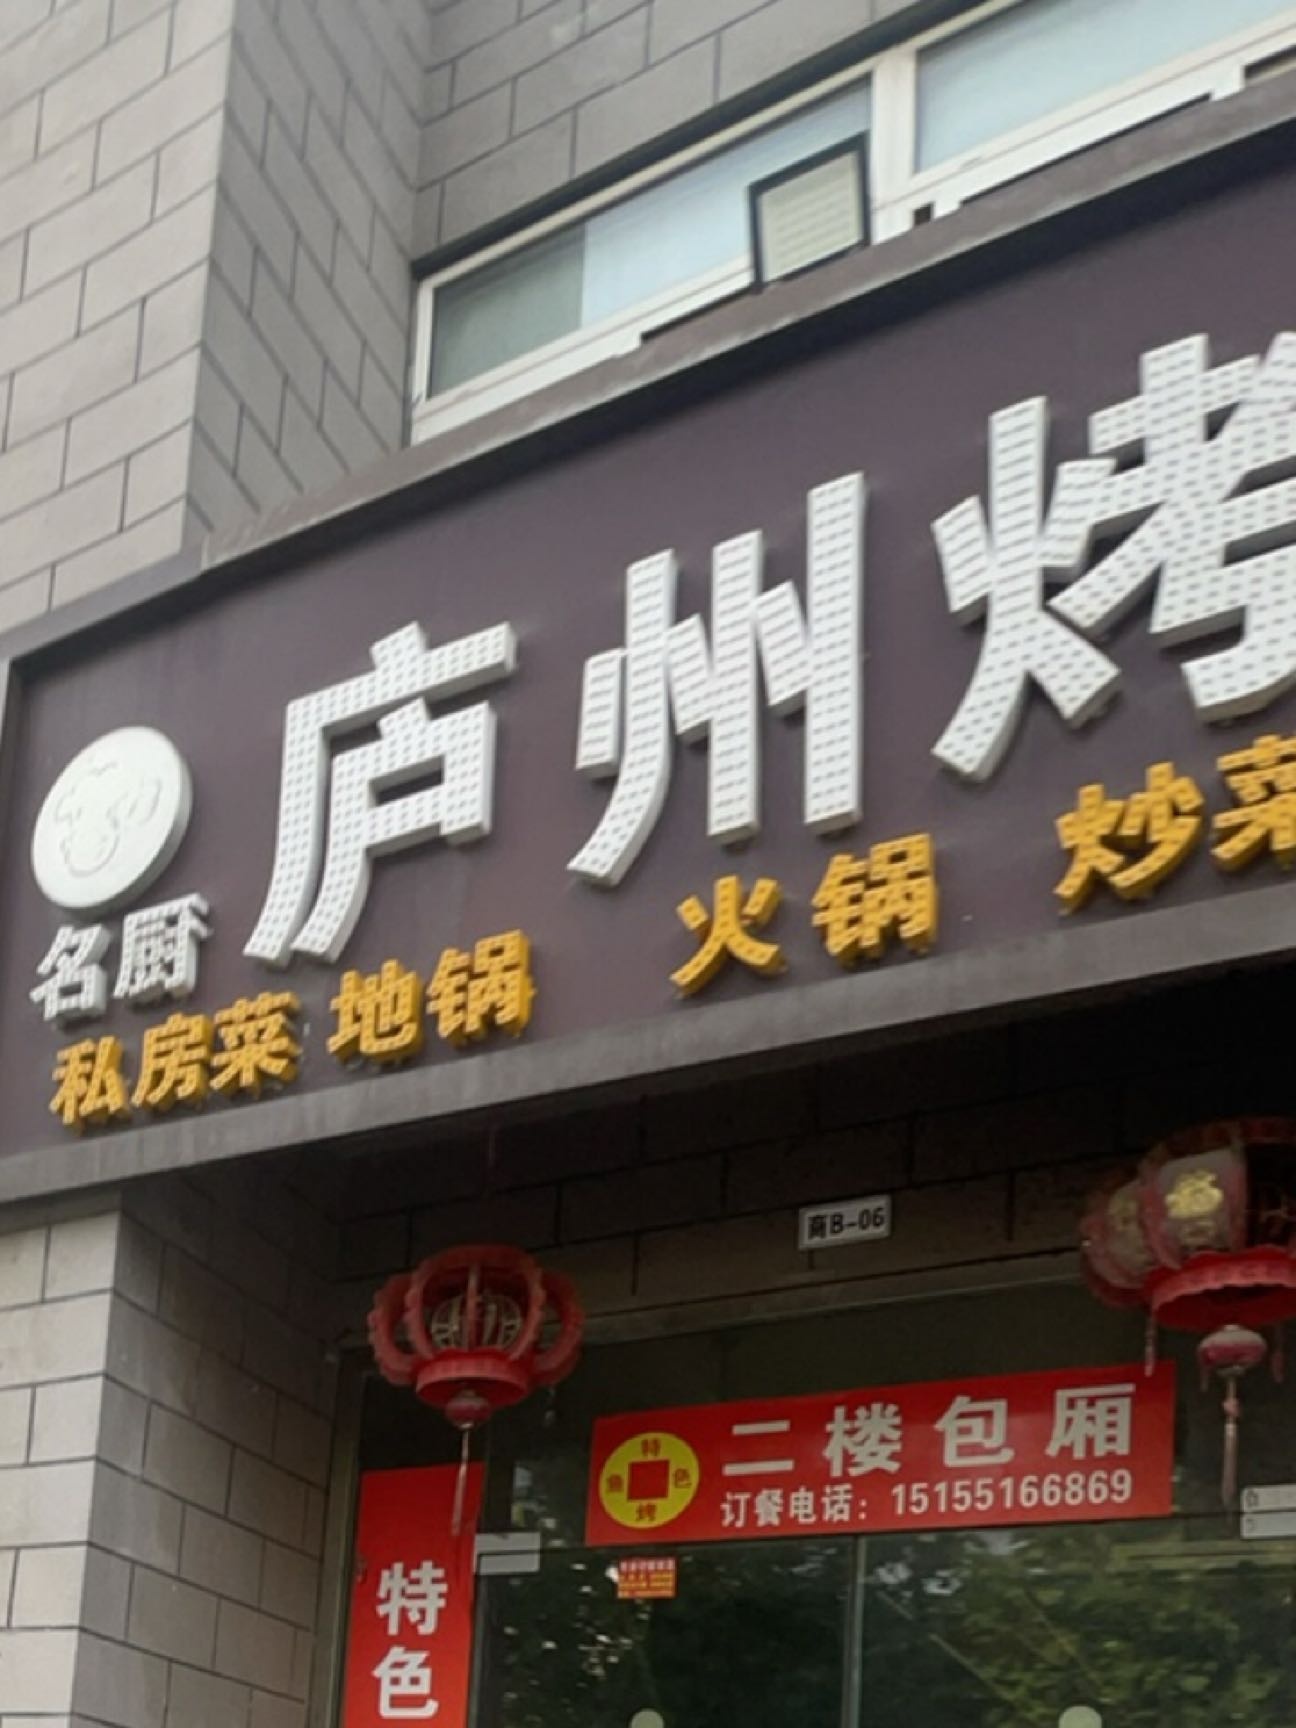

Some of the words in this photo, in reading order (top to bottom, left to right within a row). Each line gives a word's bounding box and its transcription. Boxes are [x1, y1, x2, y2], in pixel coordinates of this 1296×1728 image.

[244, 332, 1296, 968] 庐州烤
[30, 893, 212, 1027] 名厨
[50, 992, 304, 1134] 私房菜
[327, 930, 536, 1064] 地锅
[667, 832, 940, 998] 火锅
[1053, 734, 1296, 916] 炒菜
[722, 1383, 1135, 1478] 二楼包厢
